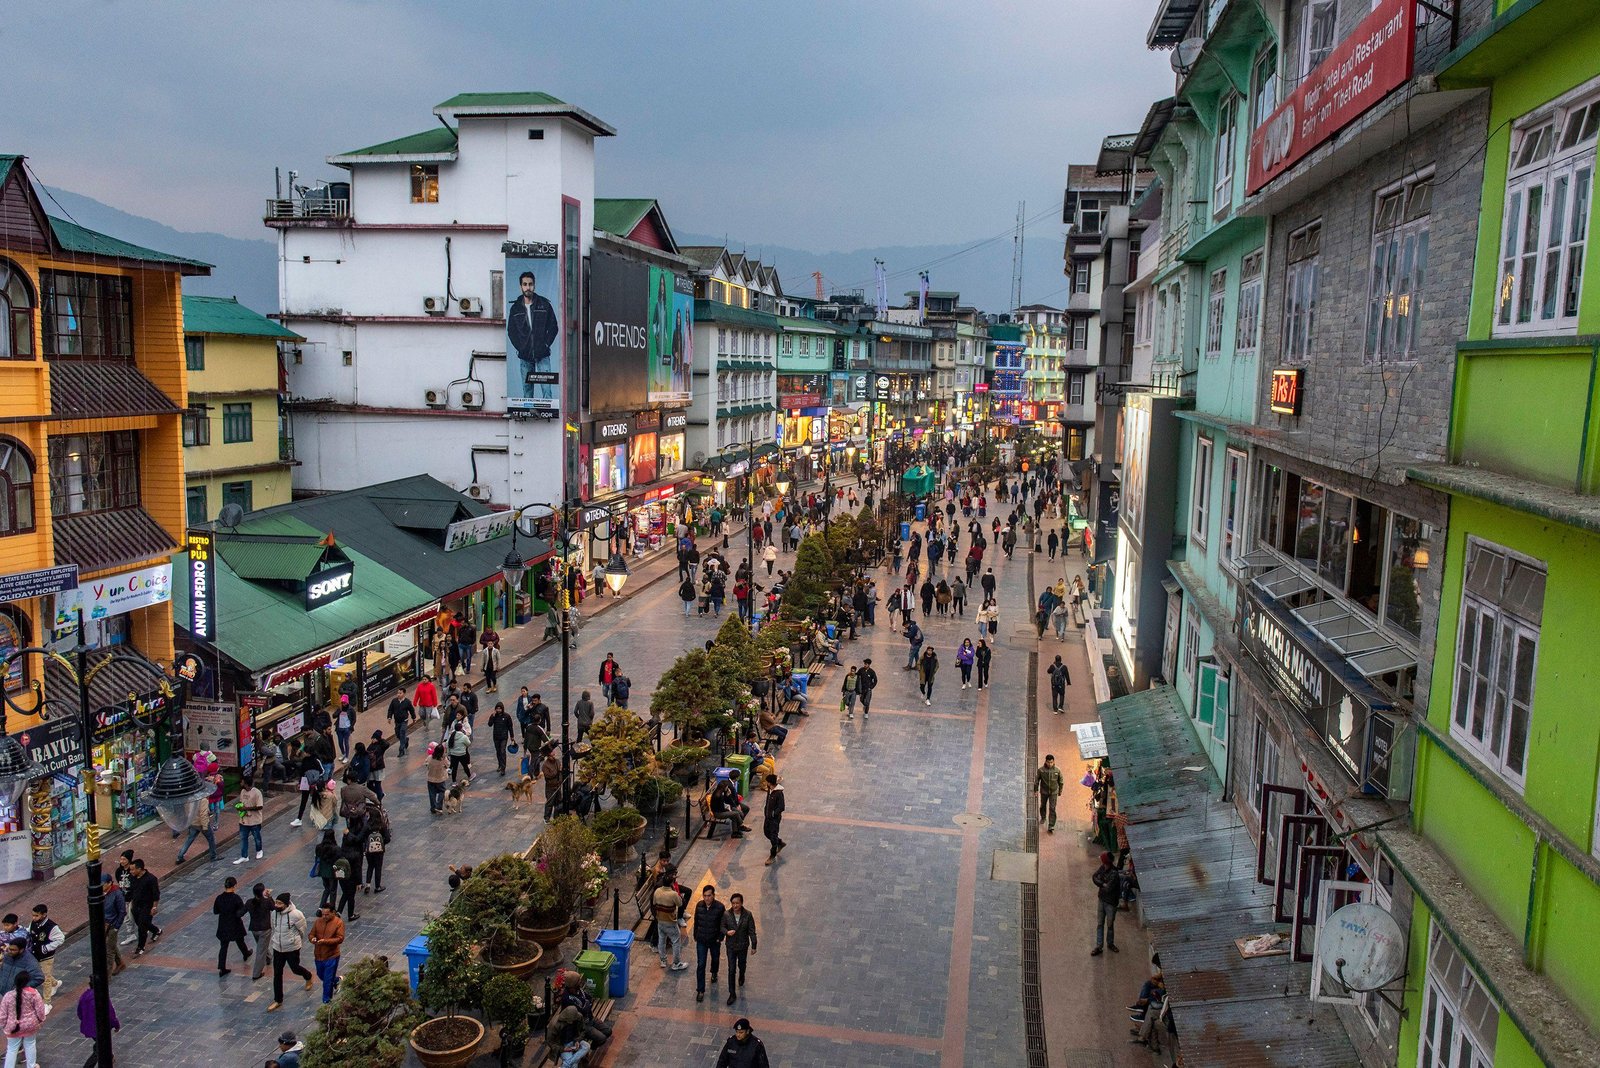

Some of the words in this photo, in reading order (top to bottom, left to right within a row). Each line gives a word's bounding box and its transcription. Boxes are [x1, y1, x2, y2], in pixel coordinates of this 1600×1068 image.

[1341, 48, 1355, 80] and
[1354, 6, 1404, 67] Restaurant
[1333, 81, 1351, 113] Tibet
[1352, 61, 1374, 99] Road
[1263, 104, 1295, 172] OYO
[604, 321, 646, 349] TRENDS
[606, 423, 628, 436] TRENDS
[671, 415, 686, 427] TRENDS
[188, 536, 210, 545] RESTRO
[190, 550, 207, 560] PUB
[15, 579, 32, 587] CREDIT
[33, 576, 53, 584] SOCIETY
[20, 571, 50, 580] ELECTRICITY
[93, 584, 125, 601] Your
[129, 575, 168, 592] Choice
[194, 560, 206, 598] PEDRO
[308, 573, 352, 599] SONY
[35, 586, 61, 595] HOME
[195, 600, 207, 637] ANUM
[1258, 612, 1285, 663] MAACH
[1284, 639, 1290, 669] &
[1291, 645, 1323, 706] MACHA
[31, 736, 80, 763] BAYUL
[50, 759, 68, 771] Cum
